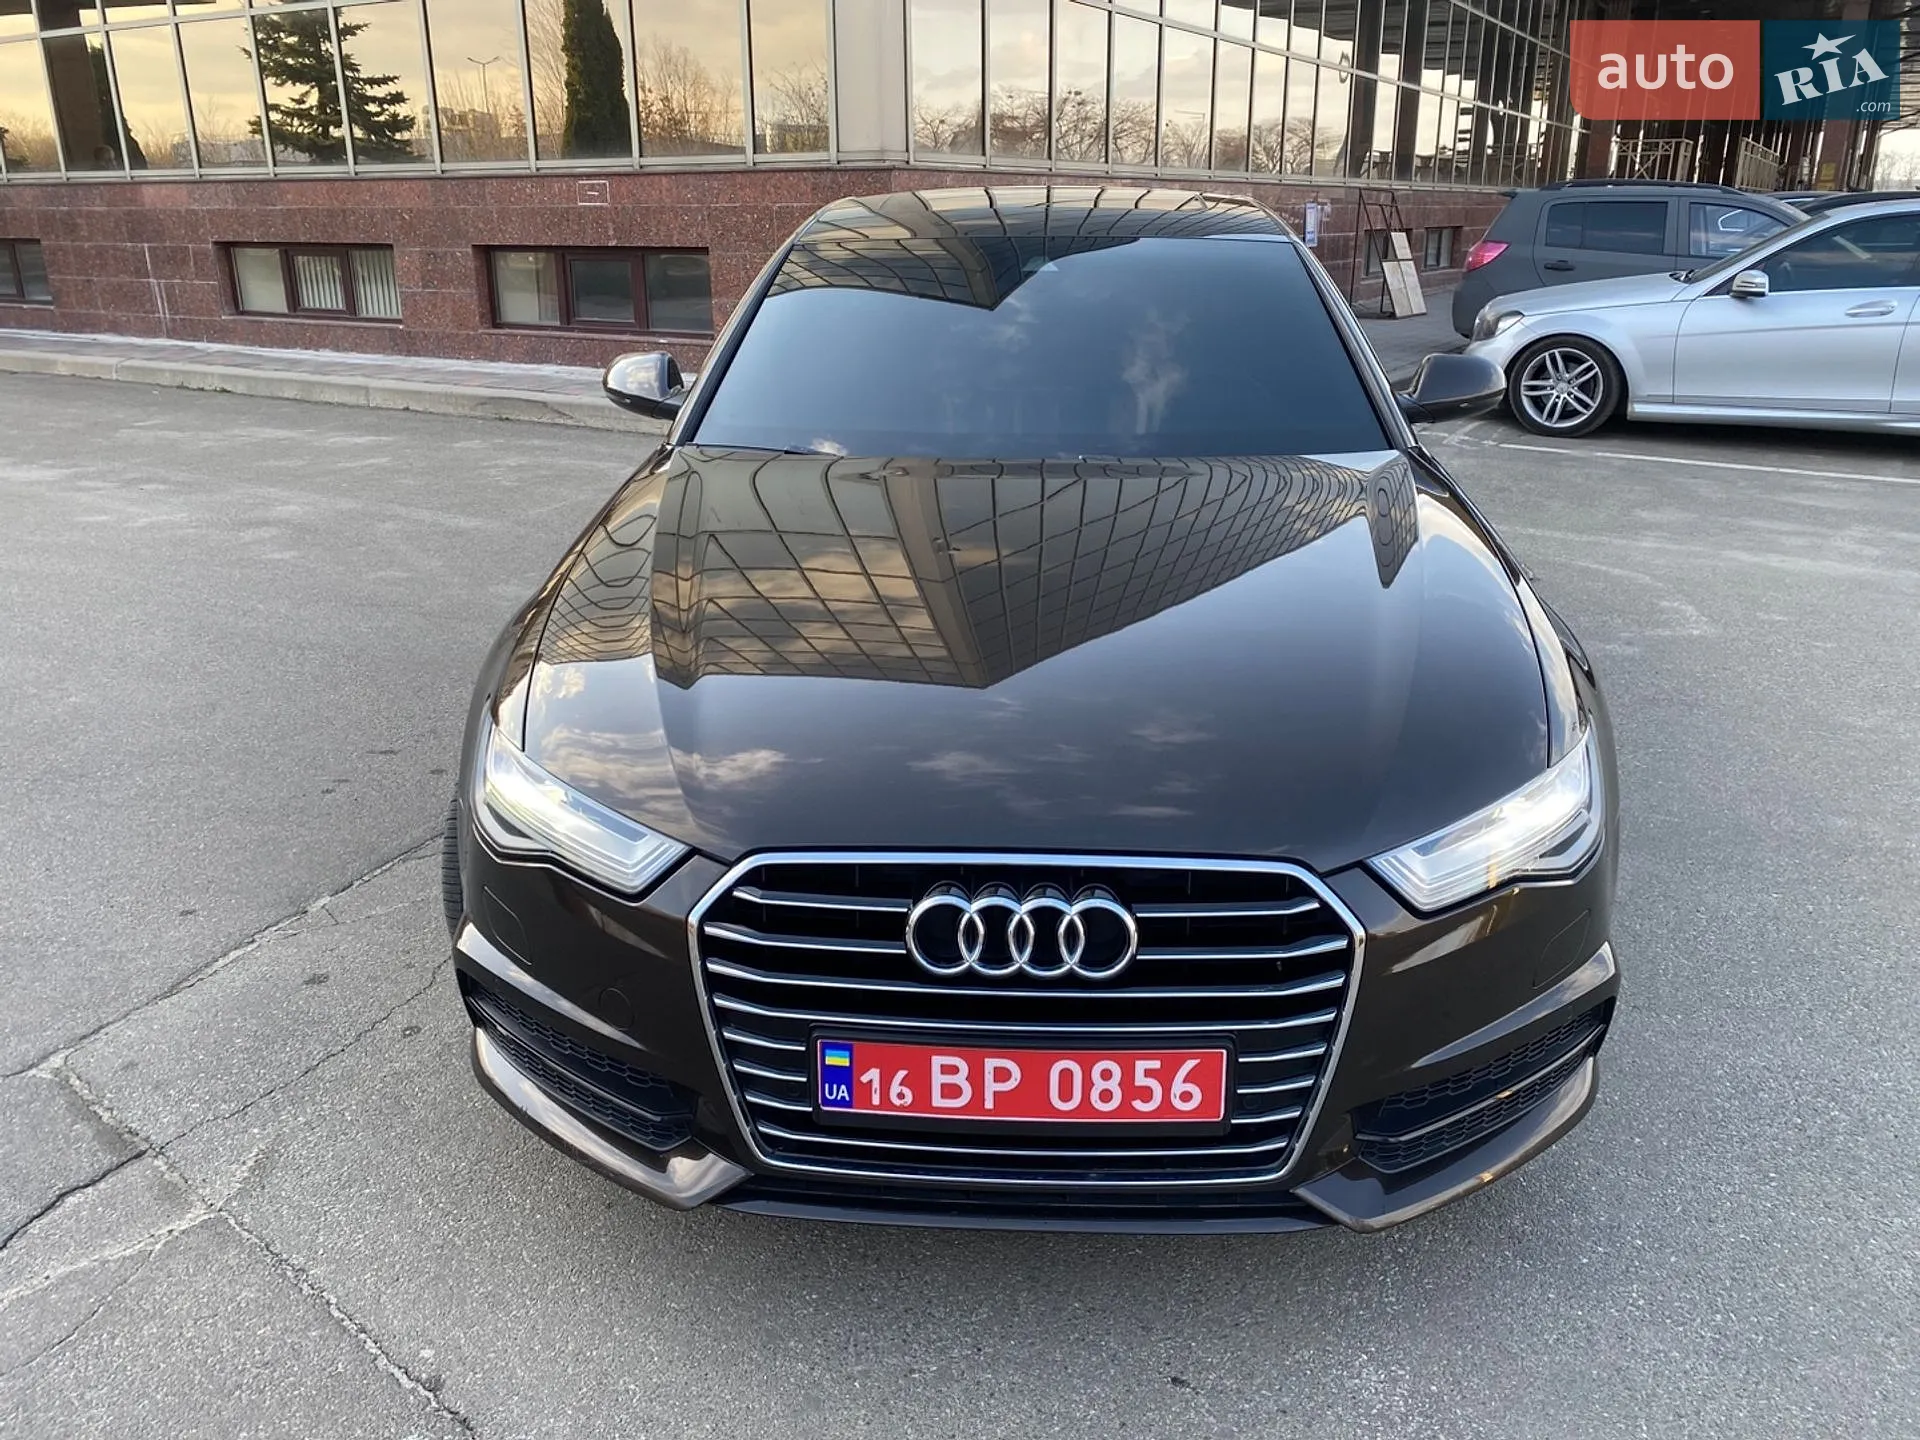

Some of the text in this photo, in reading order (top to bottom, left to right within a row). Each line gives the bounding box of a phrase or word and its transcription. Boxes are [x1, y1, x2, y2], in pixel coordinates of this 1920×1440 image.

[824, 1083, 850, 1101] UA
[859, 1055, 1204, 1112] 16 BP 0856
